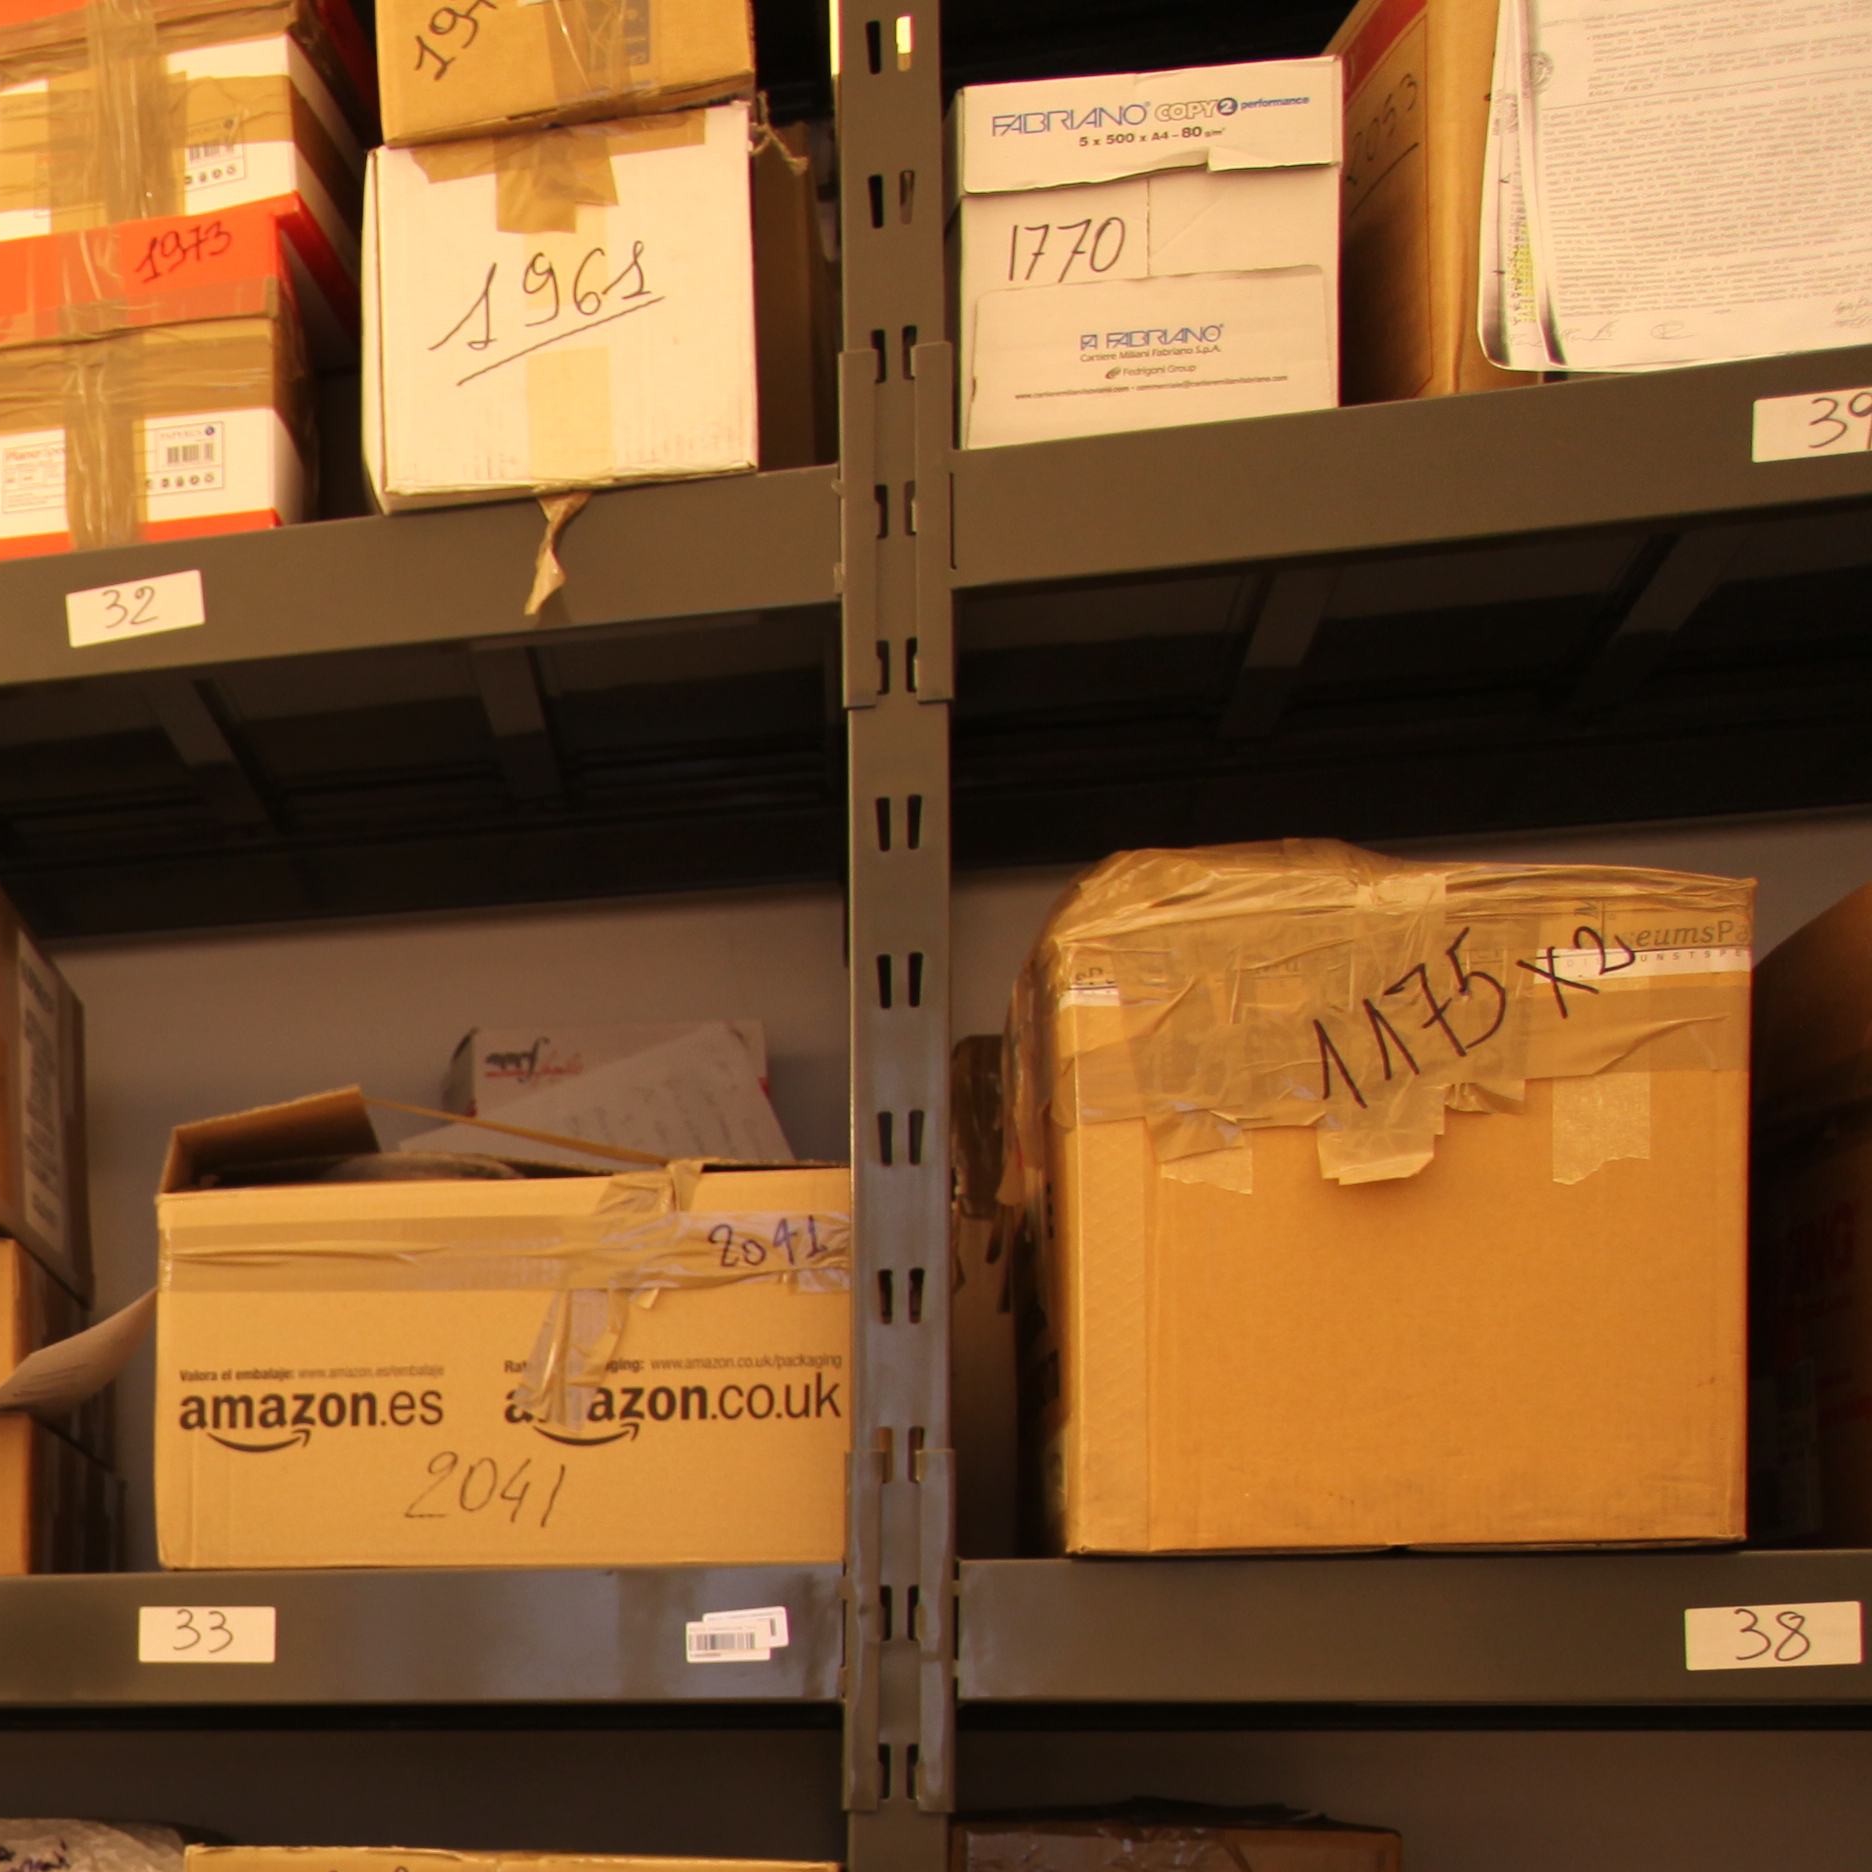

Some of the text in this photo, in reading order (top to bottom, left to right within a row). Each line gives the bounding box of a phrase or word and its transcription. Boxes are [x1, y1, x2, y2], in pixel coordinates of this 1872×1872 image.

[992, 103, 1147, 137] FABRIANO
[1079, 136, 1088, 147] 5
[1106, 132, 1135, 145] 500
[1182, 126, 1202, 138] 80
[136, 221, 233, 285] 1973
[1008, 216, 1126, 283] 1770
[430, 240, 651, 352] 1961
[1106, 324, 1222, 348] FABRIANO
[102, 585, 159, 628] 32
[180, 1370, 216, 1383] Valora
[220, 1370, 232, 1382] el
[235, 1367, 295, 1383] embalaje:
[651, 1353, 843, 1371] www.amazon.co.uk/packaging
[180, 1388, 445, 1431] amazon.es
[504, 1372, 844, 1424] aazon.co.uk
[403, 1451, 567, 1529] 2041
[172, 1609, 237, 1655] 33
[1733, 1608, 1813, 1663] 38
